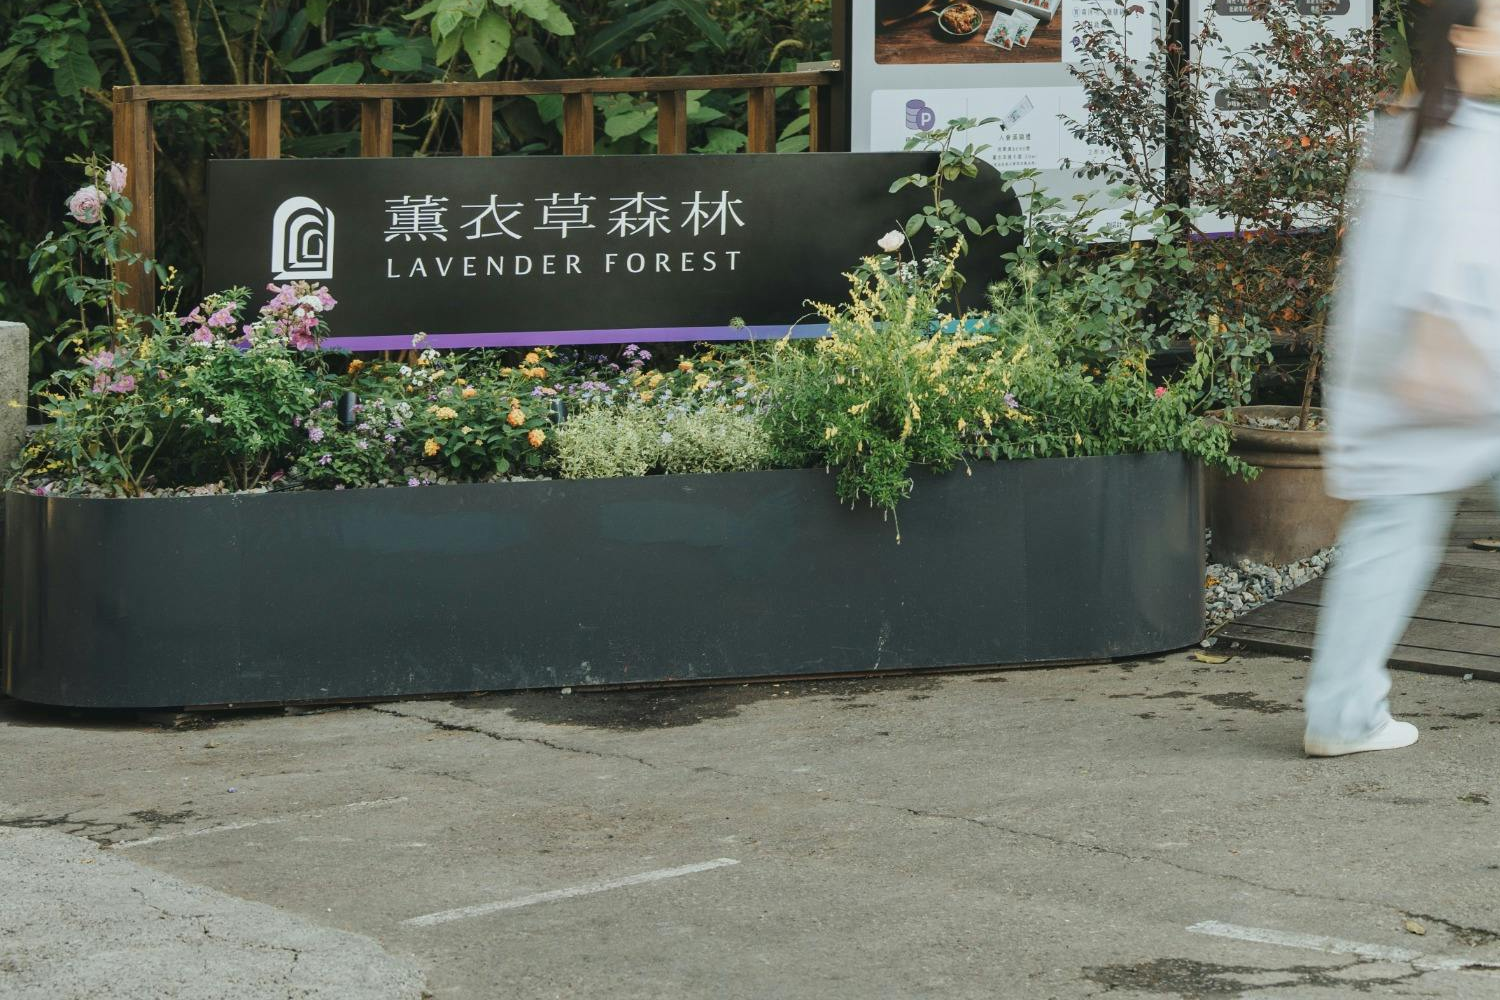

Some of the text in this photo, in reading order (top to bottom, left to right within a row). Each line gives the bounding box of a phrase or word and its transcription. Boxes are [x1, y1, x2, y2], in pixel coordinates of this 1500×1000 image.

[384, 190, 745, 242] 薰衣草森林
[387, 251, 741, 279] LAVENDER FOREST
